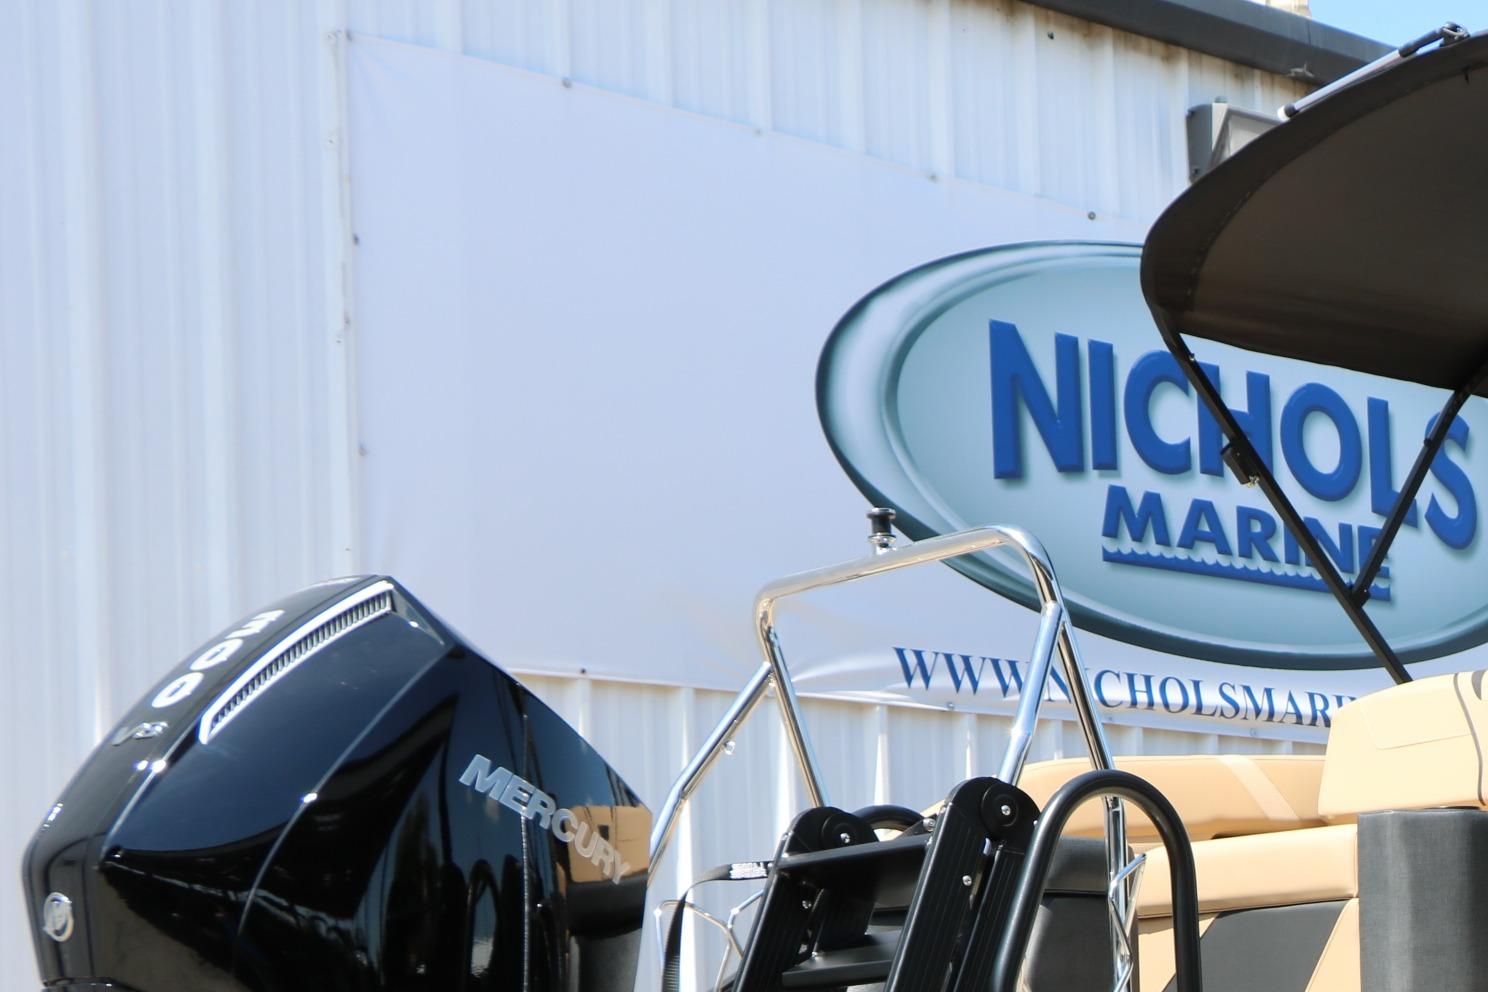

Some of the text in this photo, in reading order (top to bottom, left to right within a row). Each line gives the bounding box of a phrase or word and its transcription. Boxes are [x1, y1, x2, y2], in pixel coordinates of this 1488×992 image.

[989, 319, 1477, 549] NICHOLS
[1102, 484, 1389, 578] MARINE
[458, 753, 632, 886] MERCURY
